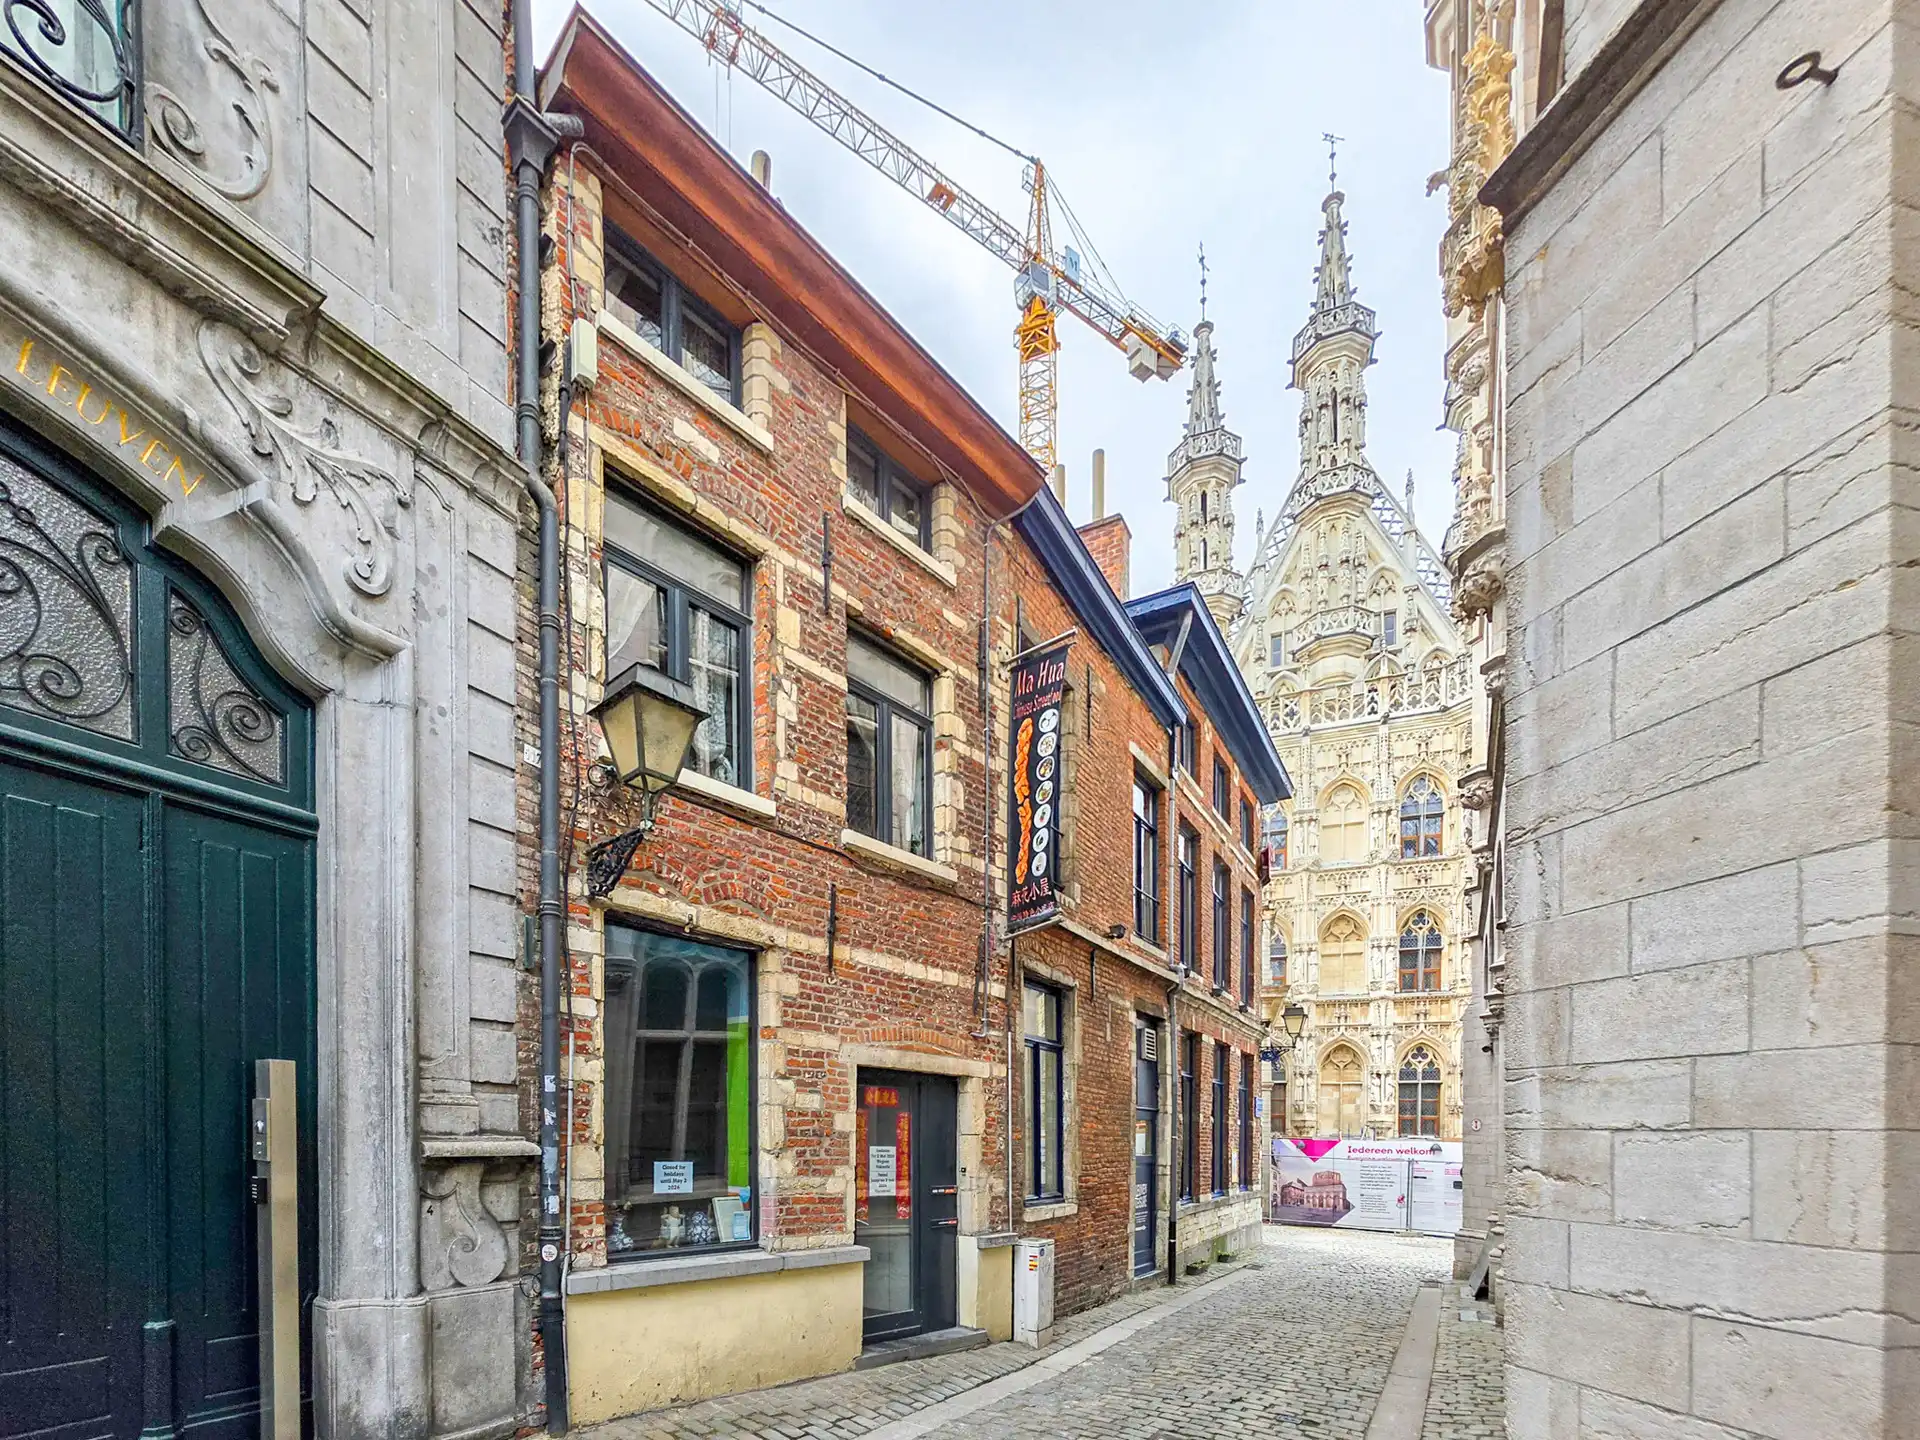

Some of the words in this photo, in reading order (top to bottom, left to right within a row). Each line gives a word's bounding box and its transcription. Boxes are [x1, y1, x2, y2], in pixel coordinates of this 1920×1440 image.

[15, 336, 205, 497] LEUVEN
[1014, 669, 1034, 698] Ma
[1038, 659, 1064, 689] Hua
[1011, 877, 1052, 908] 麻花小屋
[1347, 1145, 1393, 1154] Iedereen
[1395, 1146, 1436, 1156] welkom
[427, 1205, 434, 1216] 4
